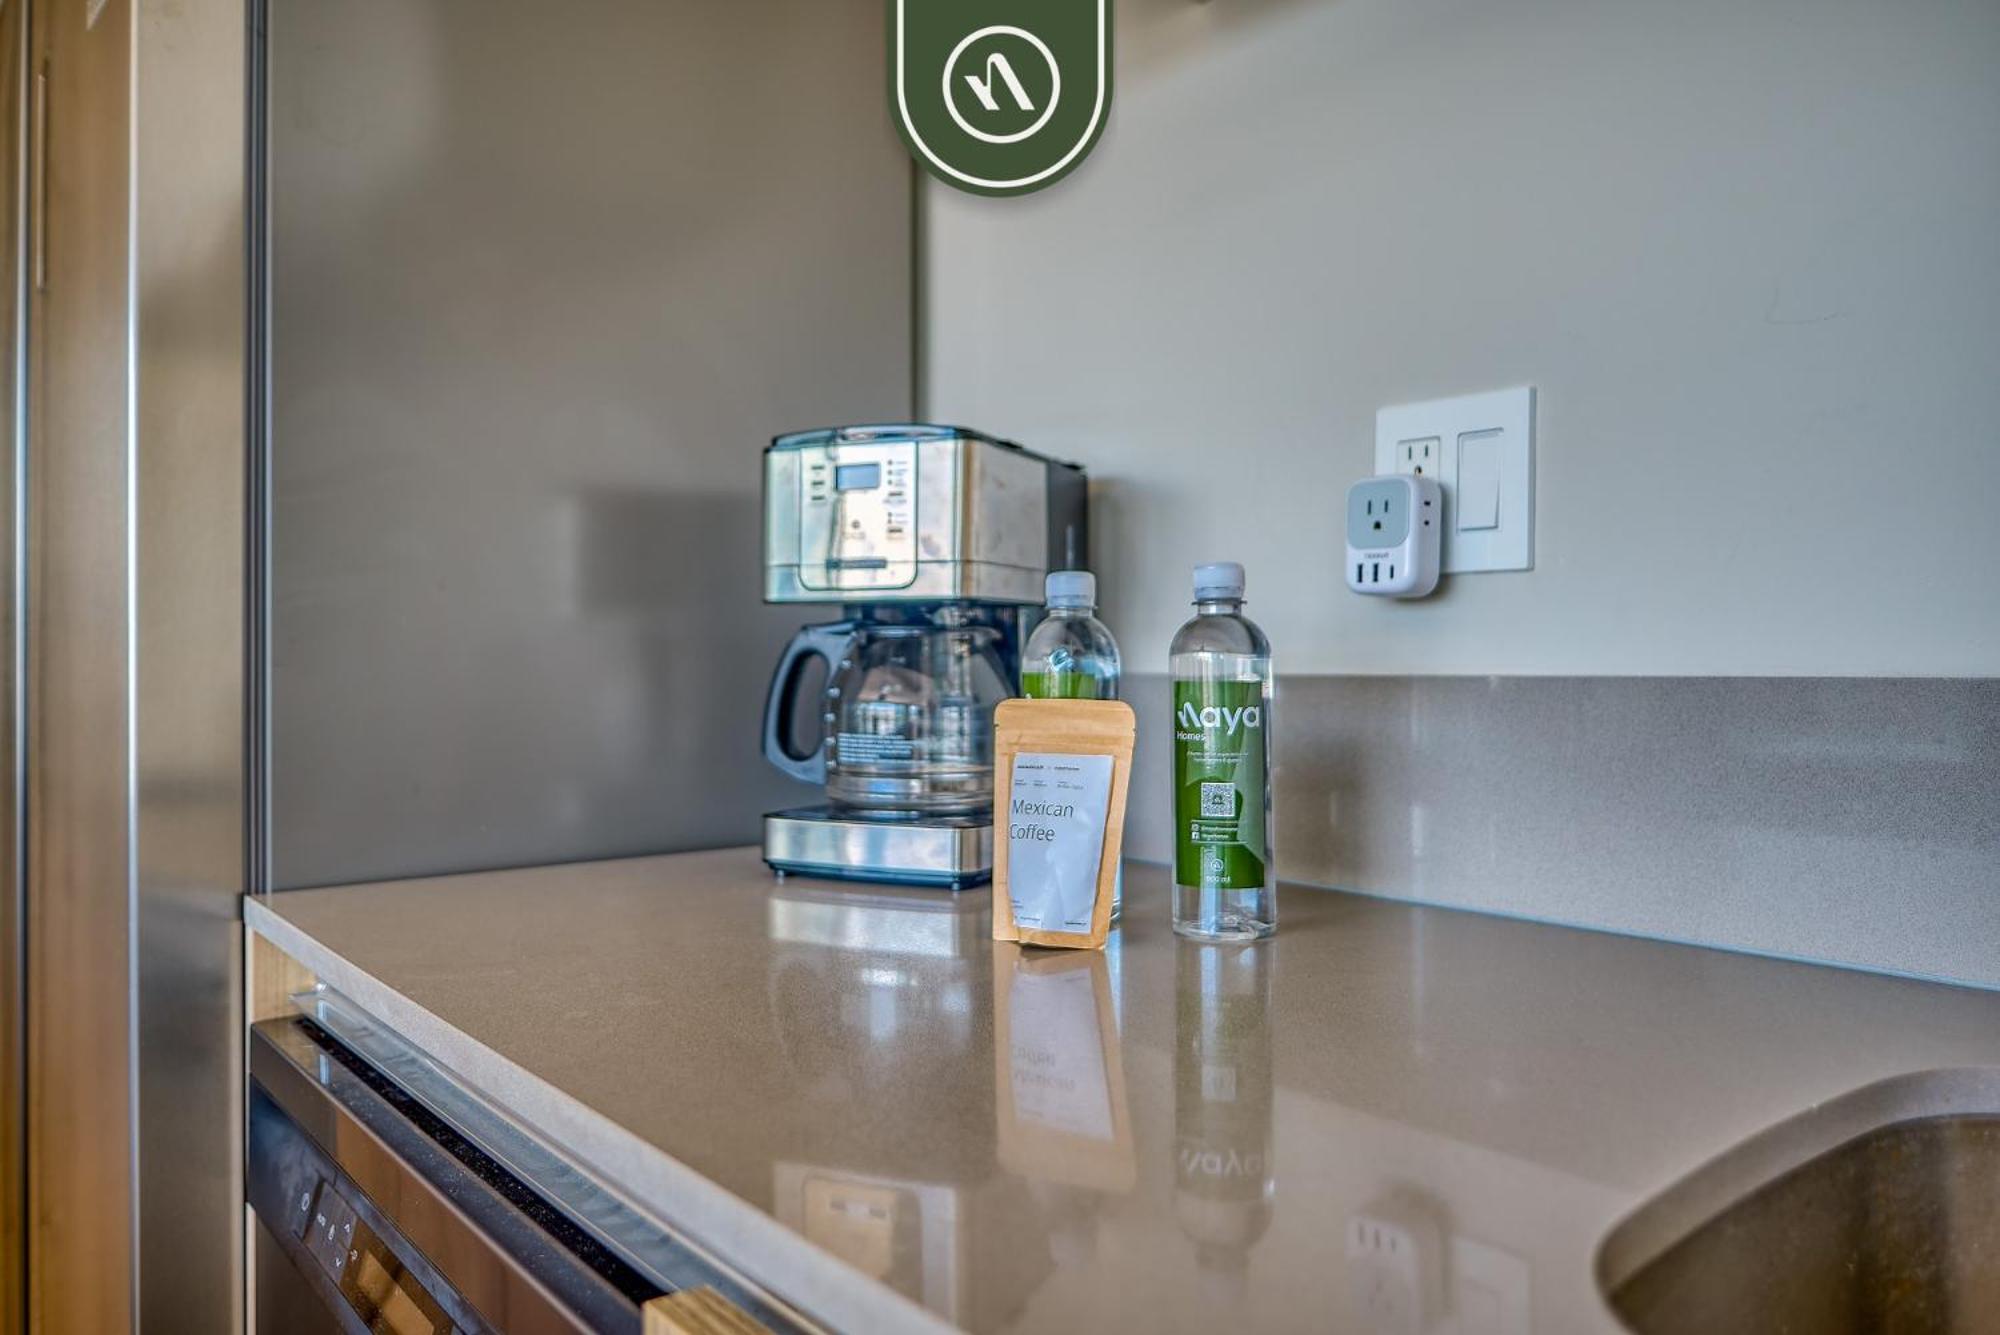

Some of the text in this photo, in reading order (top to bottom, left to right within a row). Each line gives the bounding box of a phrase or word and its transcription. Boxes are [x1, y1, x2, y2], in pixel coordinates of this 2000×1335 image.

[1176, 730, 1206, 741] Homes
[1012, 799, 1074, 818] Mexican
[1009, 822, 1056, 841] Coffee
